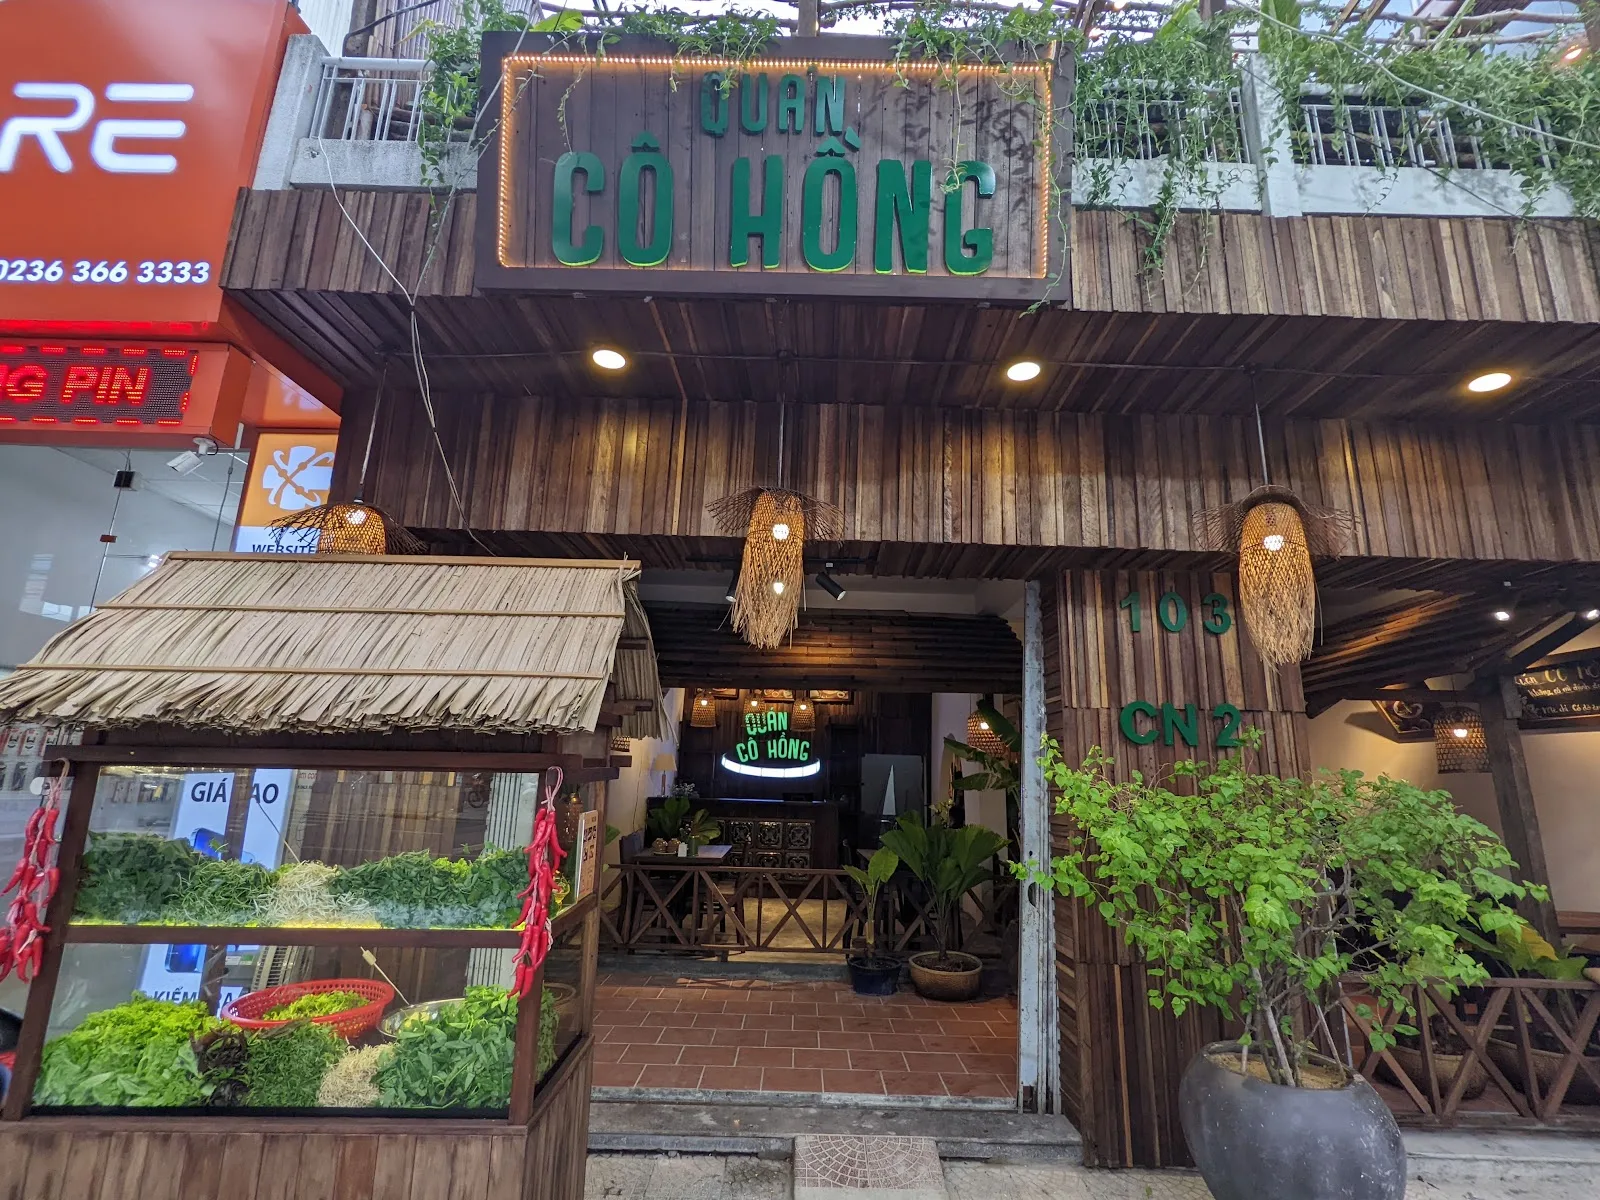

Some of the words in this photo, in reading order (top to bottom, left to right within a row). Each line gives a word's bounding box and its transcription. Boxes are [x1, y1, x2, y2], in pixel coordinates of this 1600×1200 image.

[551, 130, 674, 268] CÔ
[728, 127, 996, 276] HỒNG
[0, 259, 63, 282] 0236
[72, 260, 128, 283] 366
[136, 261, 210, 284] 3333
[61, 365, 150, 405] PIN
[745, 707, 788, 735] QUÁN
[1119, 701, 1199, 746] CN
[1213, 703, 1241, 747] 2
[736, 736, 759, 763] CÔ
[768, 732, 810, 761] HỒNG
[191, 778, 227, 802] GIÁ
